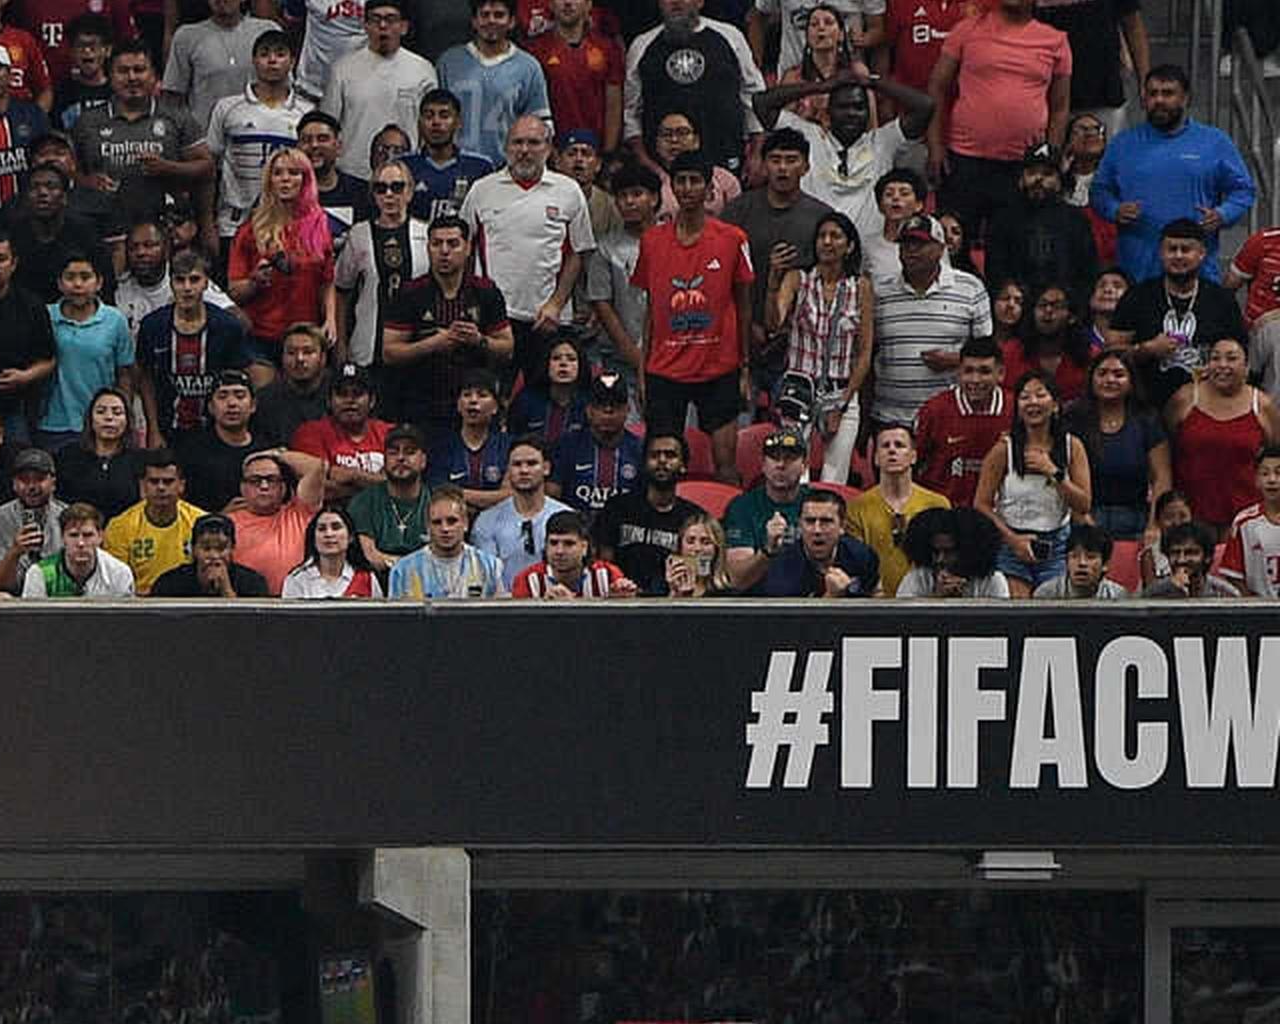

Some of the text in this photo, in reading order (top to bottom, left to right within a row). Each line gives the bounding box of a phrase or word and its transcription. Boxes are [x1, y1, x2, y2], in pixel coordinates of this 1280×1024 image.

[43, 23, 62, 47] T
[101, 141, 163, 156] Emirates
[132, 538, 155, 559] 22
[745, 636, 1280, 788] #FIFACW
